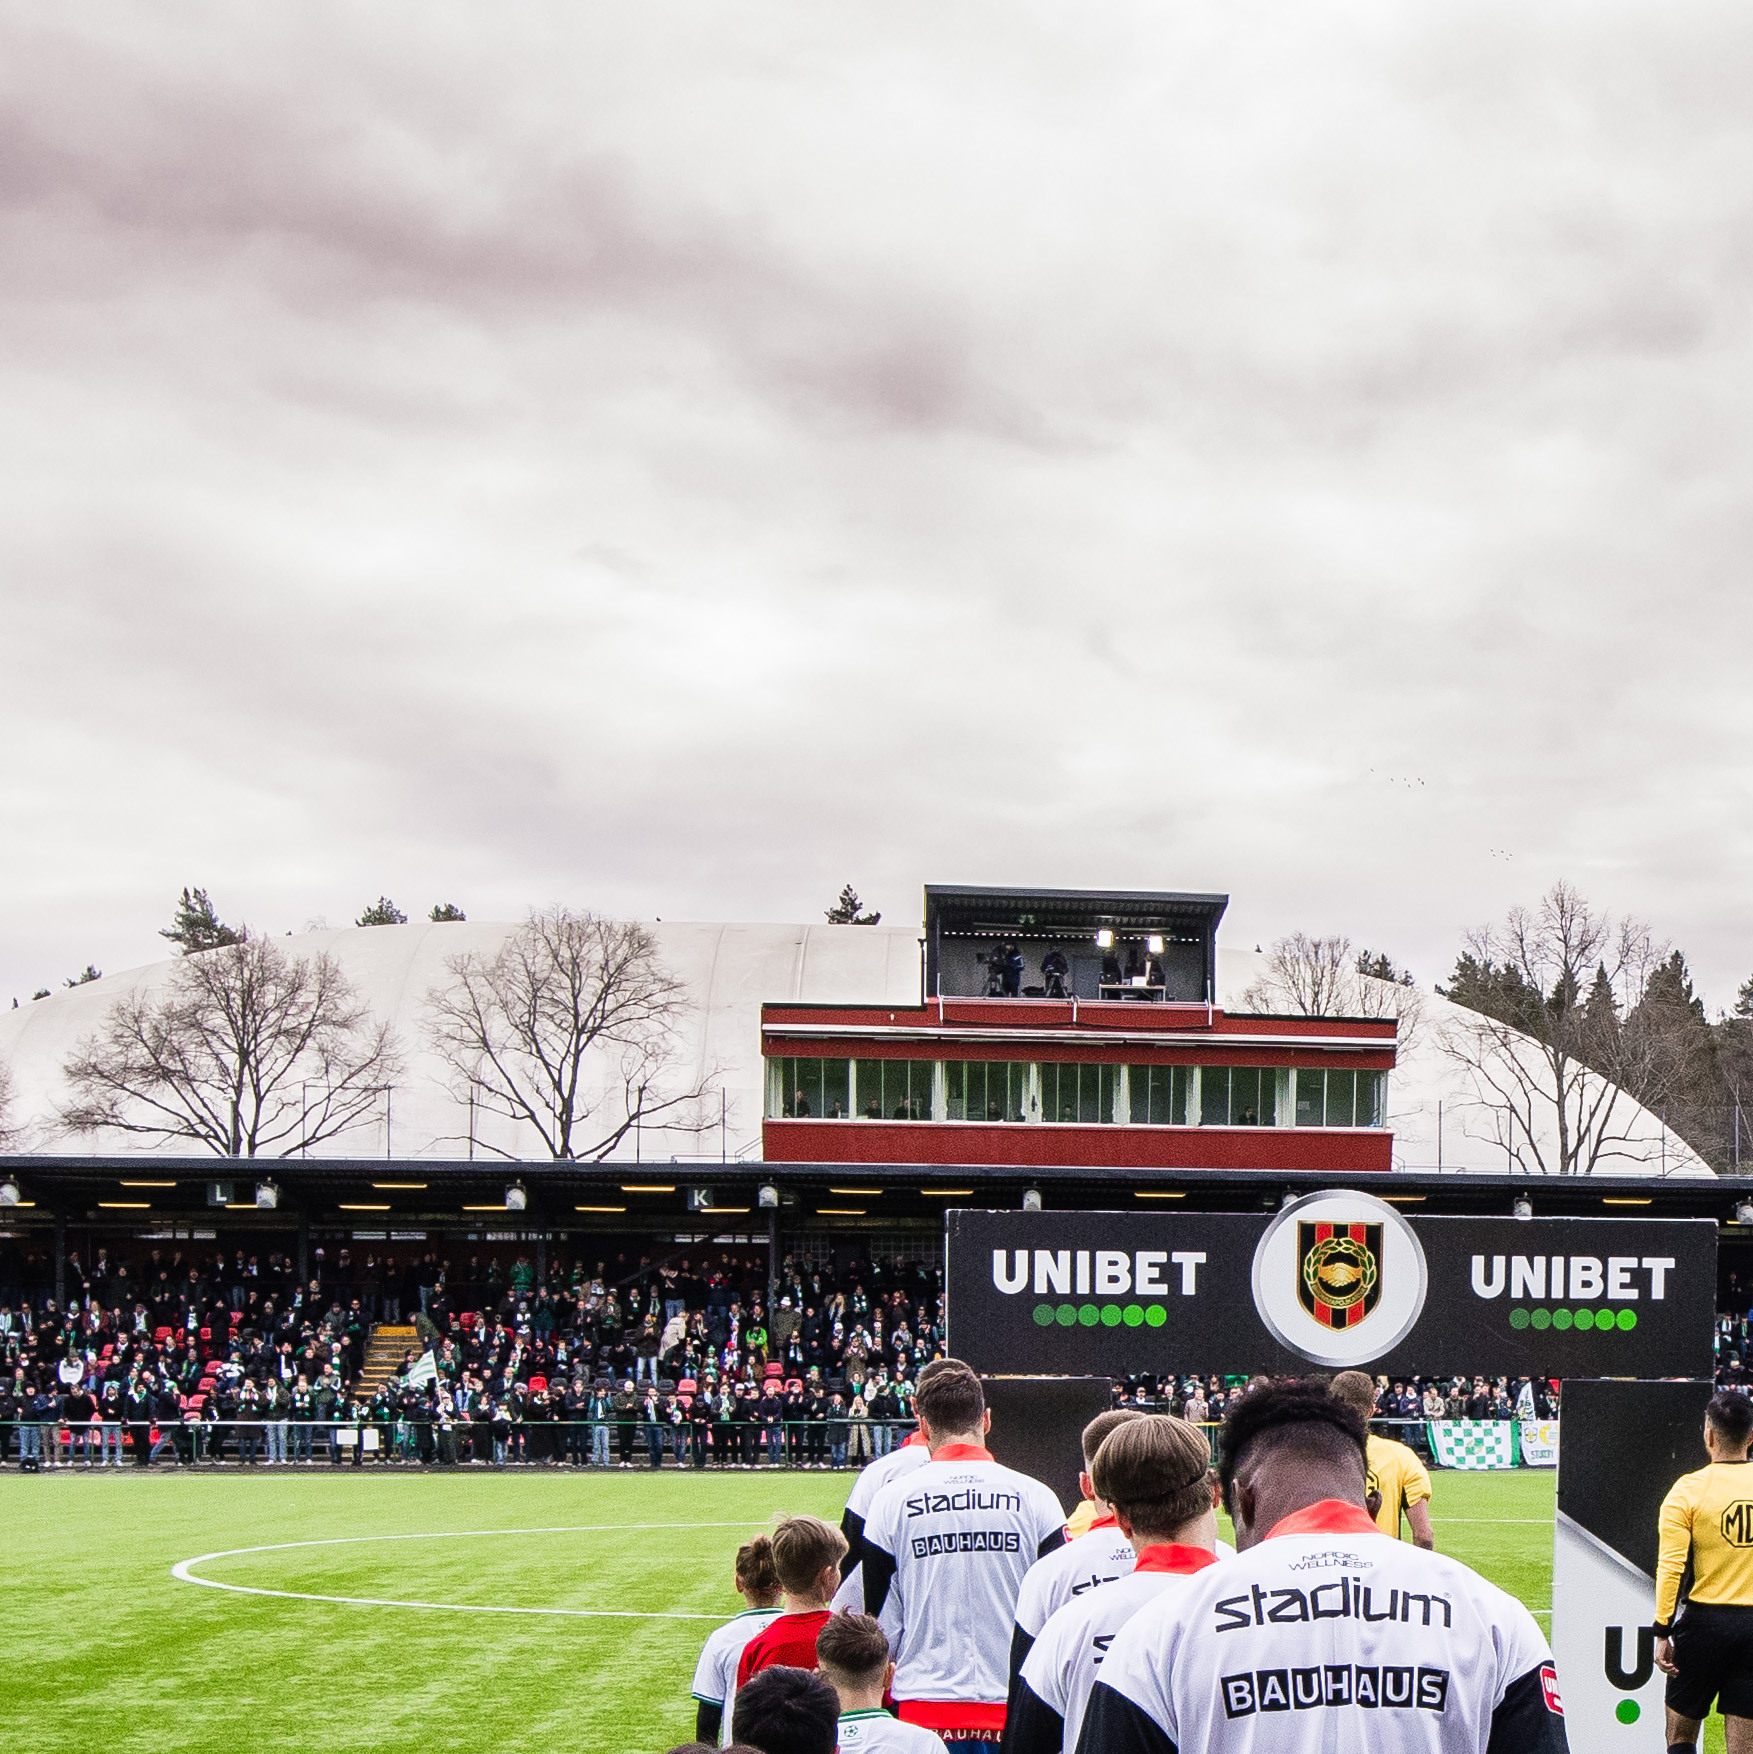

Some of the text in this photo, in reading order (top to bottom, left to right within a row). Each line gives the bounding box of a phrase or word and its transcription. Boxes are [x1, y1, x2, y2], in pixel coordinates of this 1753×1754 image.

[215, 1184, 227, 1201] L
[694, 1189, 708, 1206] K
[993, 1250, 1206, 1295] UNIBET
[1472, 1255, 1675, 1300] UNIBET
[907, 1489, 1021, 1518] stadium
[913, 1532, 1019, 1557] BAUHAUS
[1302, 1551, 1359, 1562] NORDIC
[1289, 1560, 1373, 1571] WELLNESS
[1223, 1667, 1447, 1717] BAUHAUS
